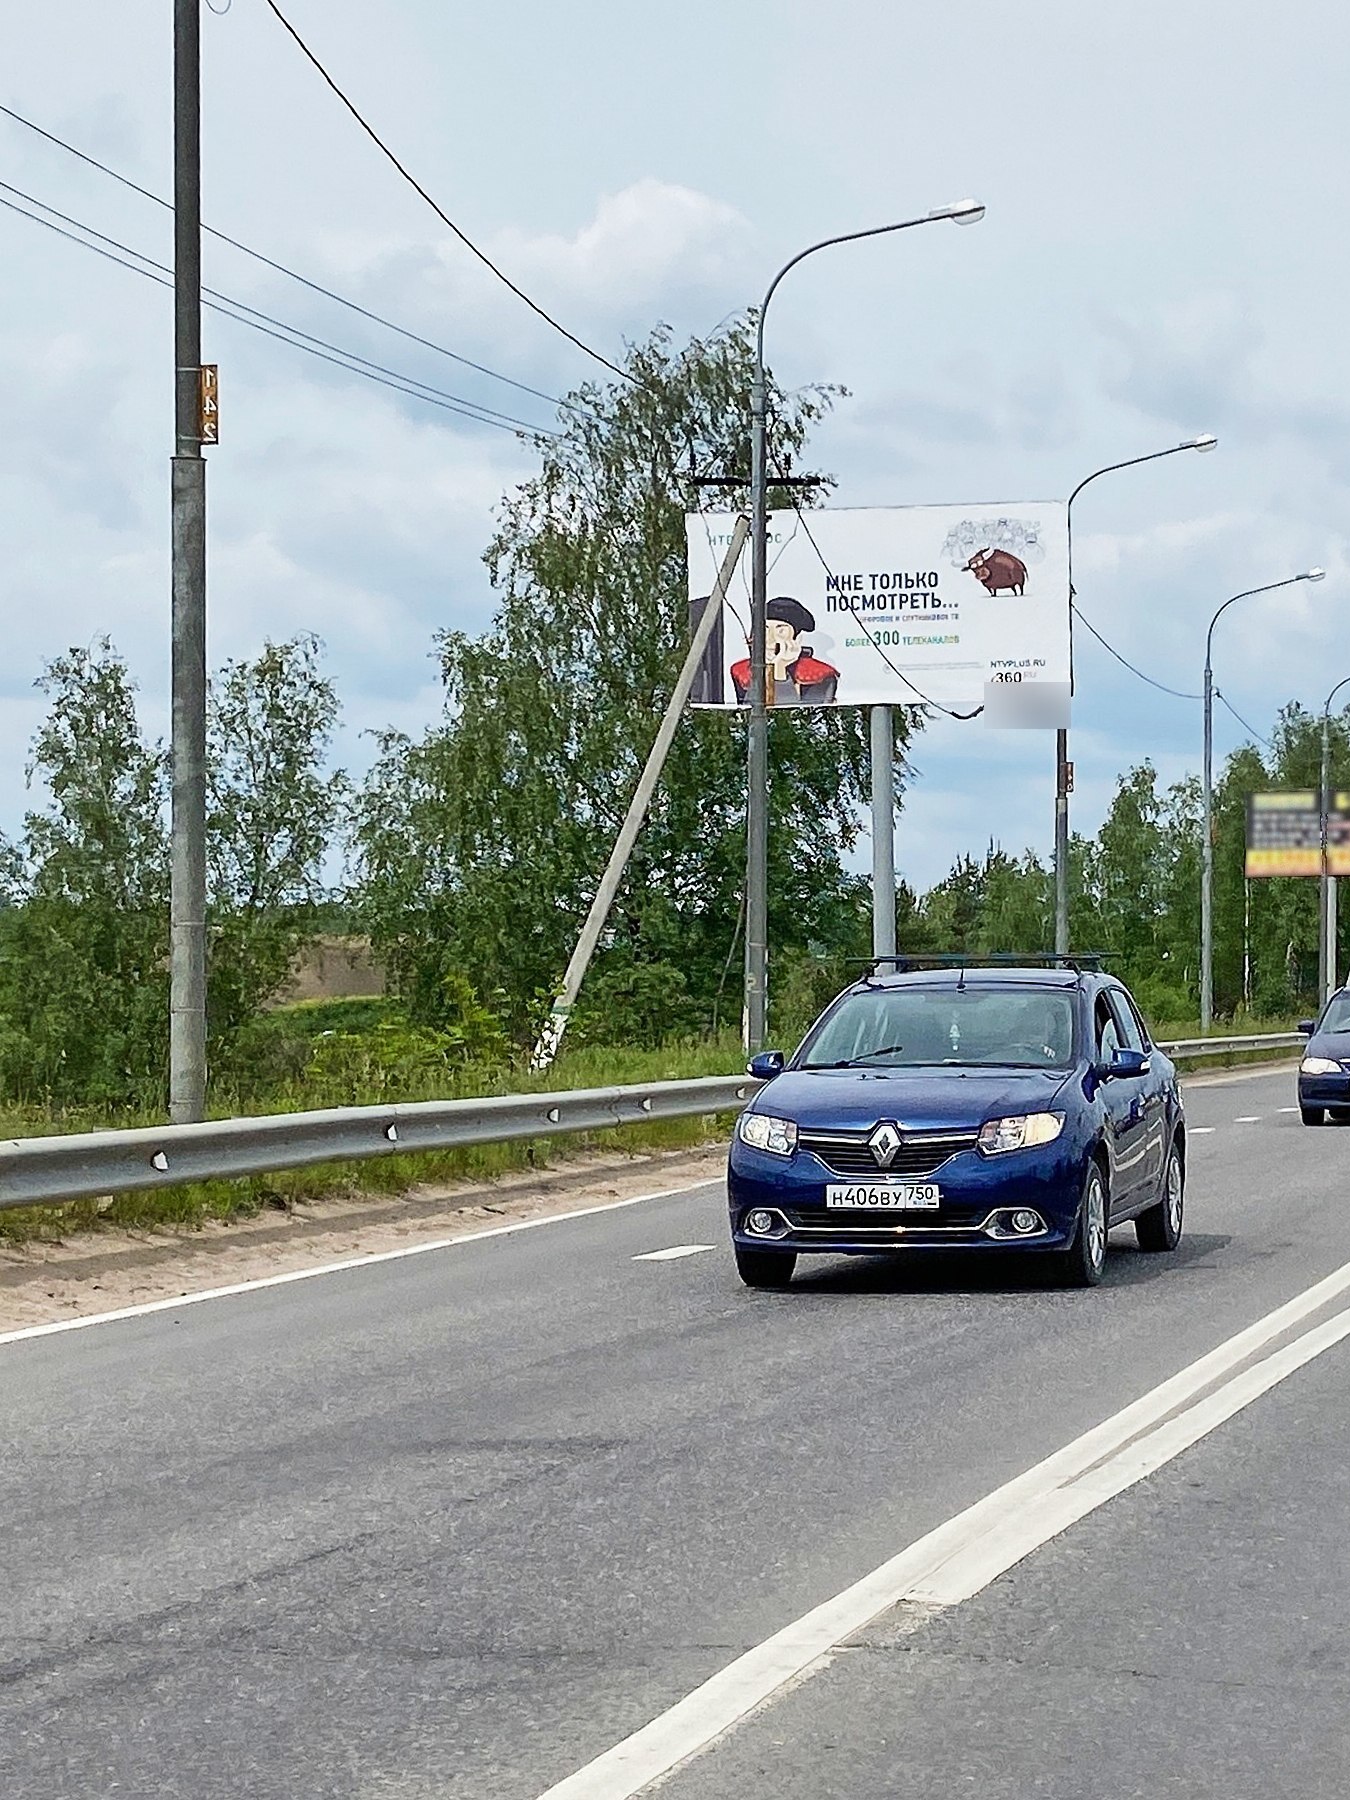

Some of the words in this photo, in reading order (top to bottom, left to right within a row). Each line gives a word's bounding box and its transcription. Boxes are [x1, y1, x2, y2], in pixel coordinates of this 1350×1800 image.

[826, 574, 863, 591] МНЕ
[869, 571, 938, 590] ТОЛЬКО
[826, 592, 959, 612] ПОСМОТРЕТЬ...
[845, 637, 872, 647] БОЛЕЕ
[873, 630, 900, 646] 300
[902, 635, 959, 646] ТЕЛЕКАНАЛОВ
[906, 1187, 934, 1200] 750
